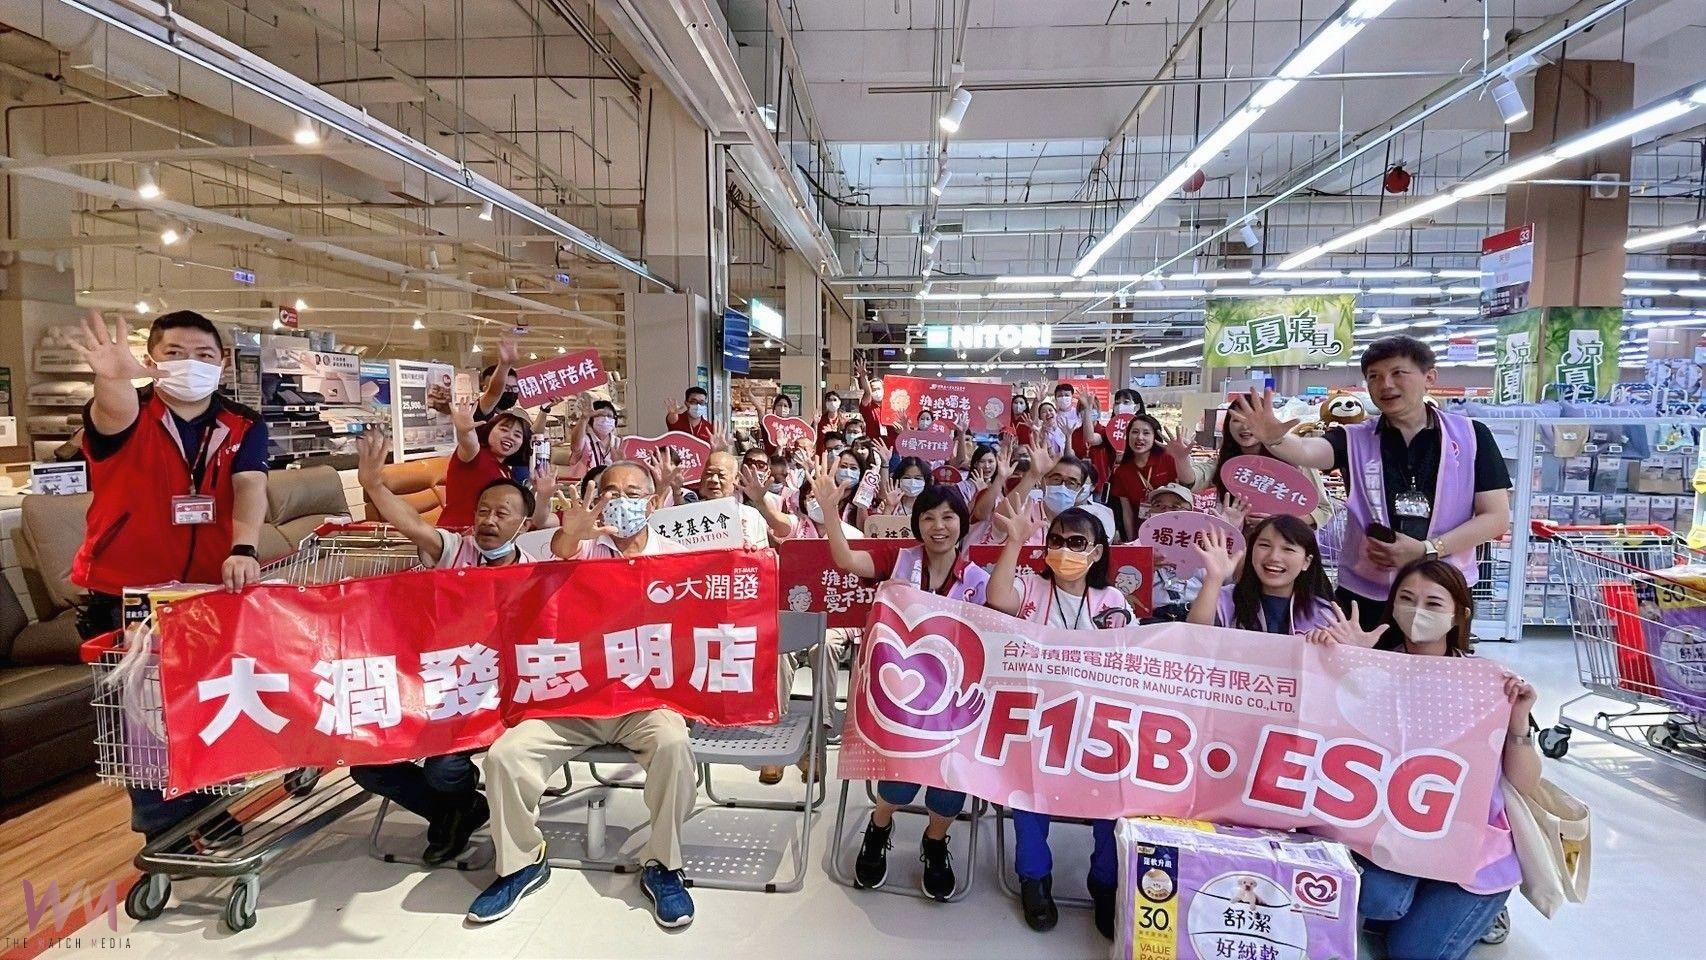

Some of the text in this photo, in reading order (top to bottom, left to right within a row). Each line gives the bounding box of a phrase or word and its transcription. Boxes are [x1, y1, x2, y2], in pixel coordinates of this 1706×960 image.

[951, 324, 1052, 348] NITORI
[517, 358, 599, 399] 關懷陪伴
[901, 437, 949, 451] #愛不打烊
[1233, 467, 1308, 506] 活躍老化
[675, 573, 759, 600] 大潤發
[198, 622, 757, 747] 大潤發忠明店
[1003, 641, 1297, 698] 台灣積體電路製造股份有限公司
[1002, 661, 1296, 714] TAIWAN SEMICONDUCTOR MANUFACTURING CO.,LTD.
[1246, 728, 1465, 834] ESG
[1139, 906, 1169, 931] 30
[1222, 908, 1272, 934] 舒潔
[1140, 943, 1171, 956] VALUE
